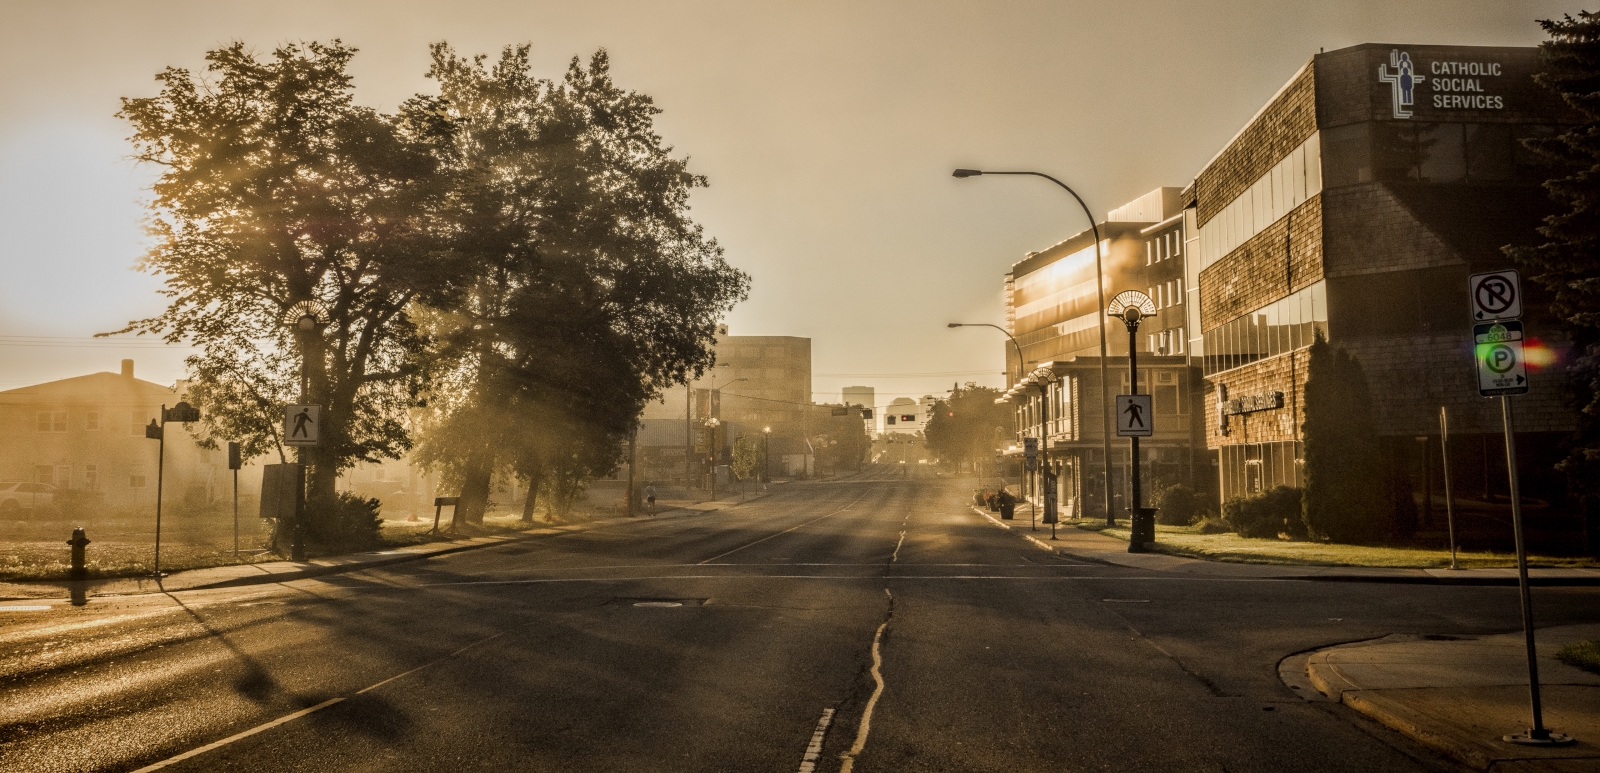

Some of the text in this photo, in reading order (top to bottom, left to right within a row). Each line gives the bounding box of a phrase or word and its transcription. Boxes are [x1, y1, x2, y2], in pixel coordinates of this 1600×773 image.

[1431, 61, 1502, 76] CATHOLIC
[1432, 78, 1484, 92] SOCIAL
[1433, 94, 1504, 109] SERVICES
[1487, 282, 1506, 306] P
[1487, 331, 1512, 342] 6048
[1494, 351, 1508, 367] P
